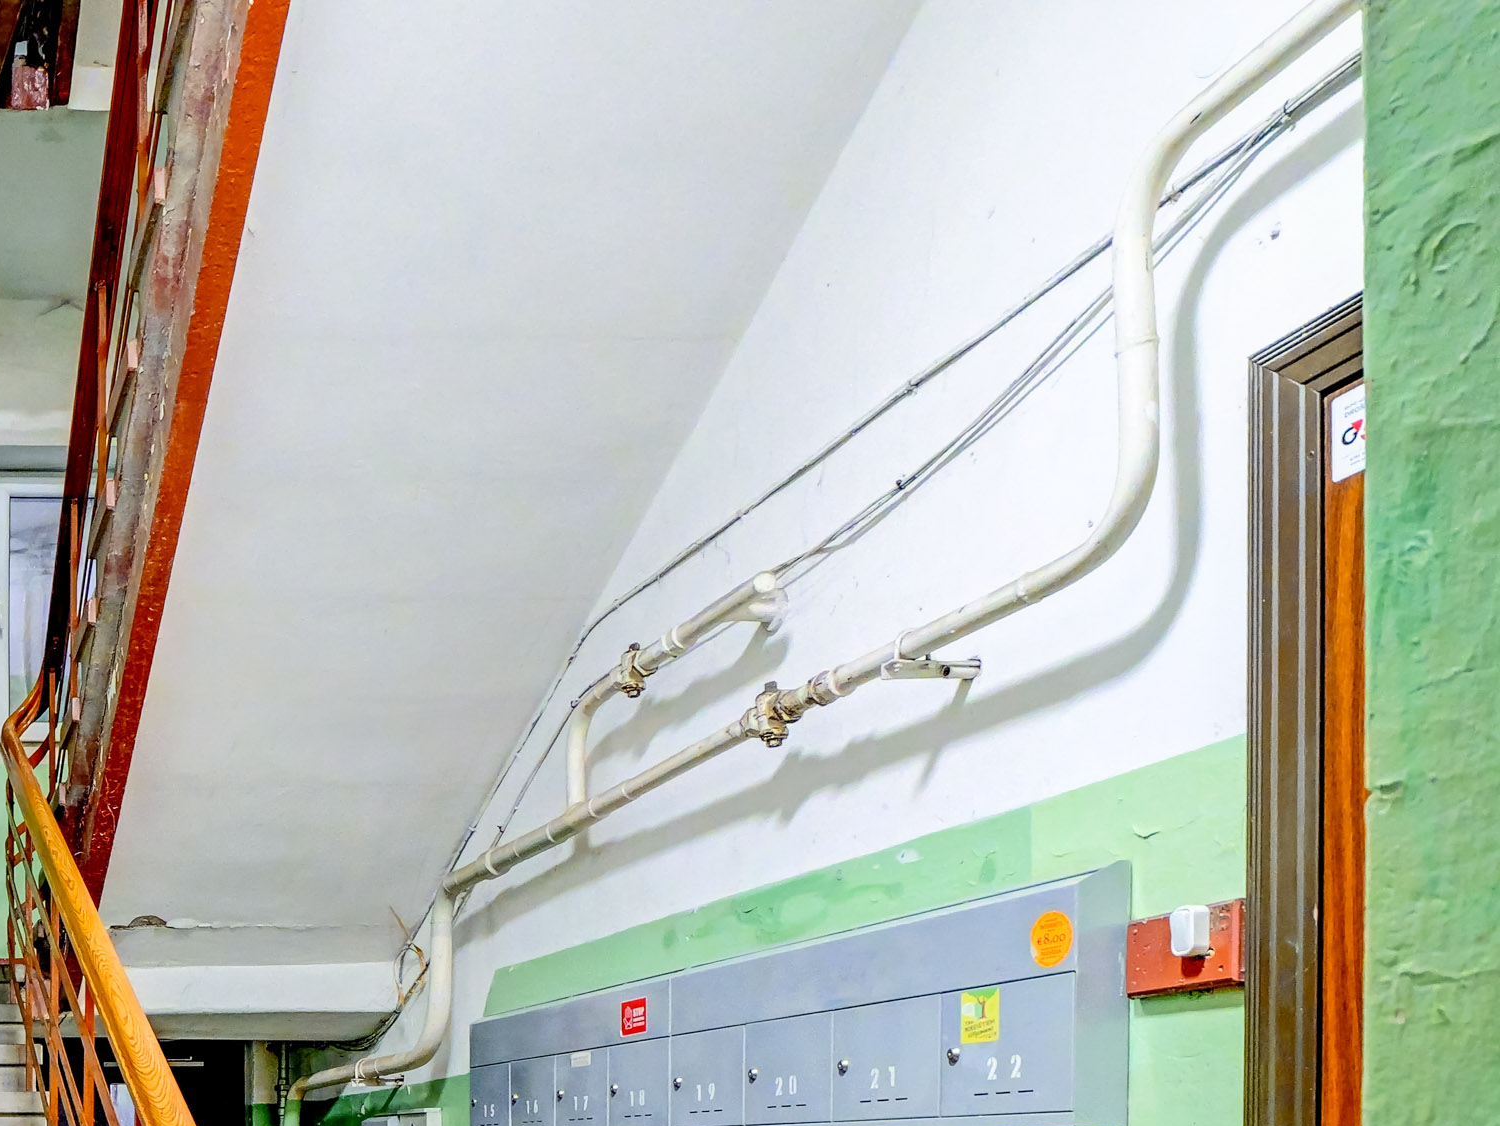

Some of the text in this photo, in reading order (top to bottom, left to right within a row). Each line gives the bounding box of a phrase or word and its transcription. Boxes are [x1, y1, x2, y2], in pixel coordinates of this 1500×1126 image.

[986, 1054, 1022, 1081] 22
[775, 1074, 798, 1097] 20
[870, 1066, 896, 1090] 21
[629, 1089, 645, 1107] 18
[696, 1082, 716, 1101] 19
[483, 1103, 495, 1118] 15
[526, 1099, 539, 1115] 16
[573, 1095, 589, 1112] 17
